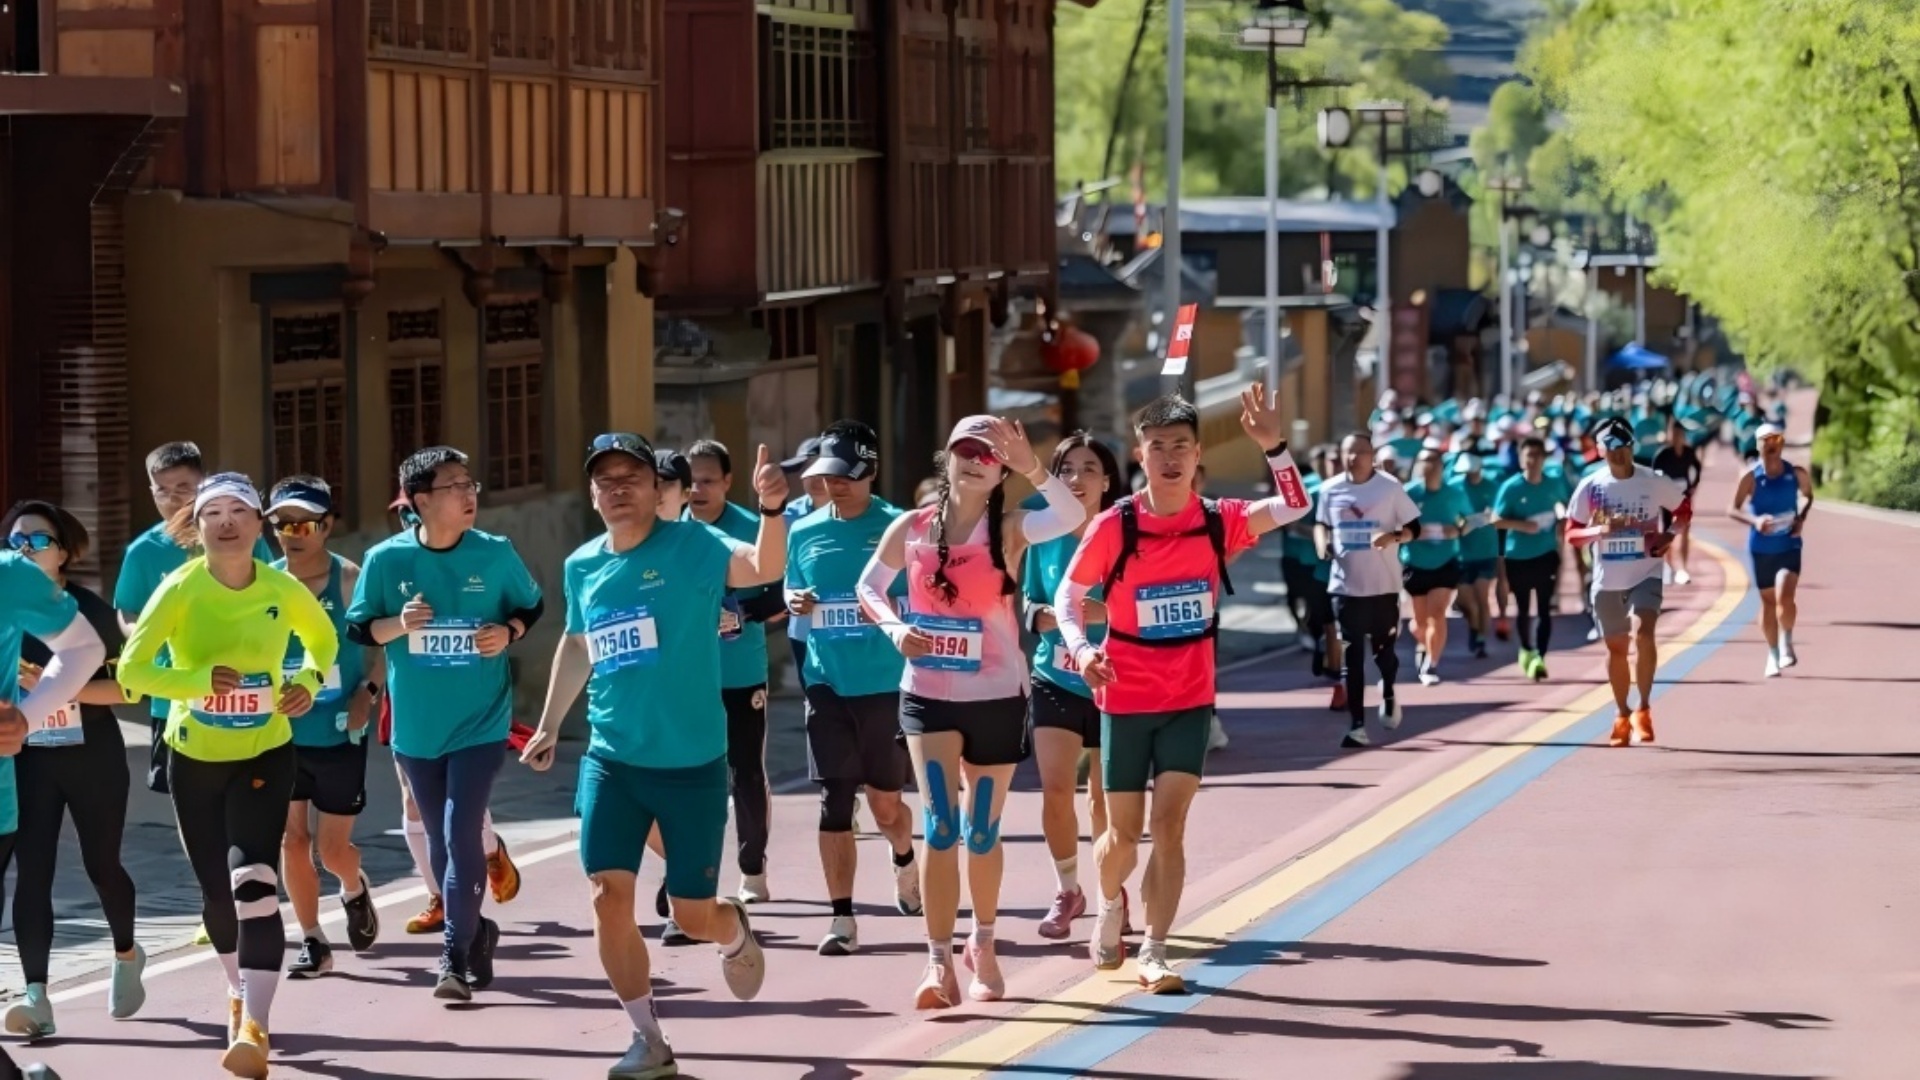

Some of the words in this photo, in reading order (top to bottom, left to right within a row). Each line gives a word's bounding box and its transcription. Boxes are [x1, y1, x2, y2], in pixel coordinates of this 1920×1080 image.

[1152, 600, 1203, 624] 11563
[421, 635, 473, 653] 12024
[593, 626, 641, 659] 12546
[203, 694, 259, 713] 20115
